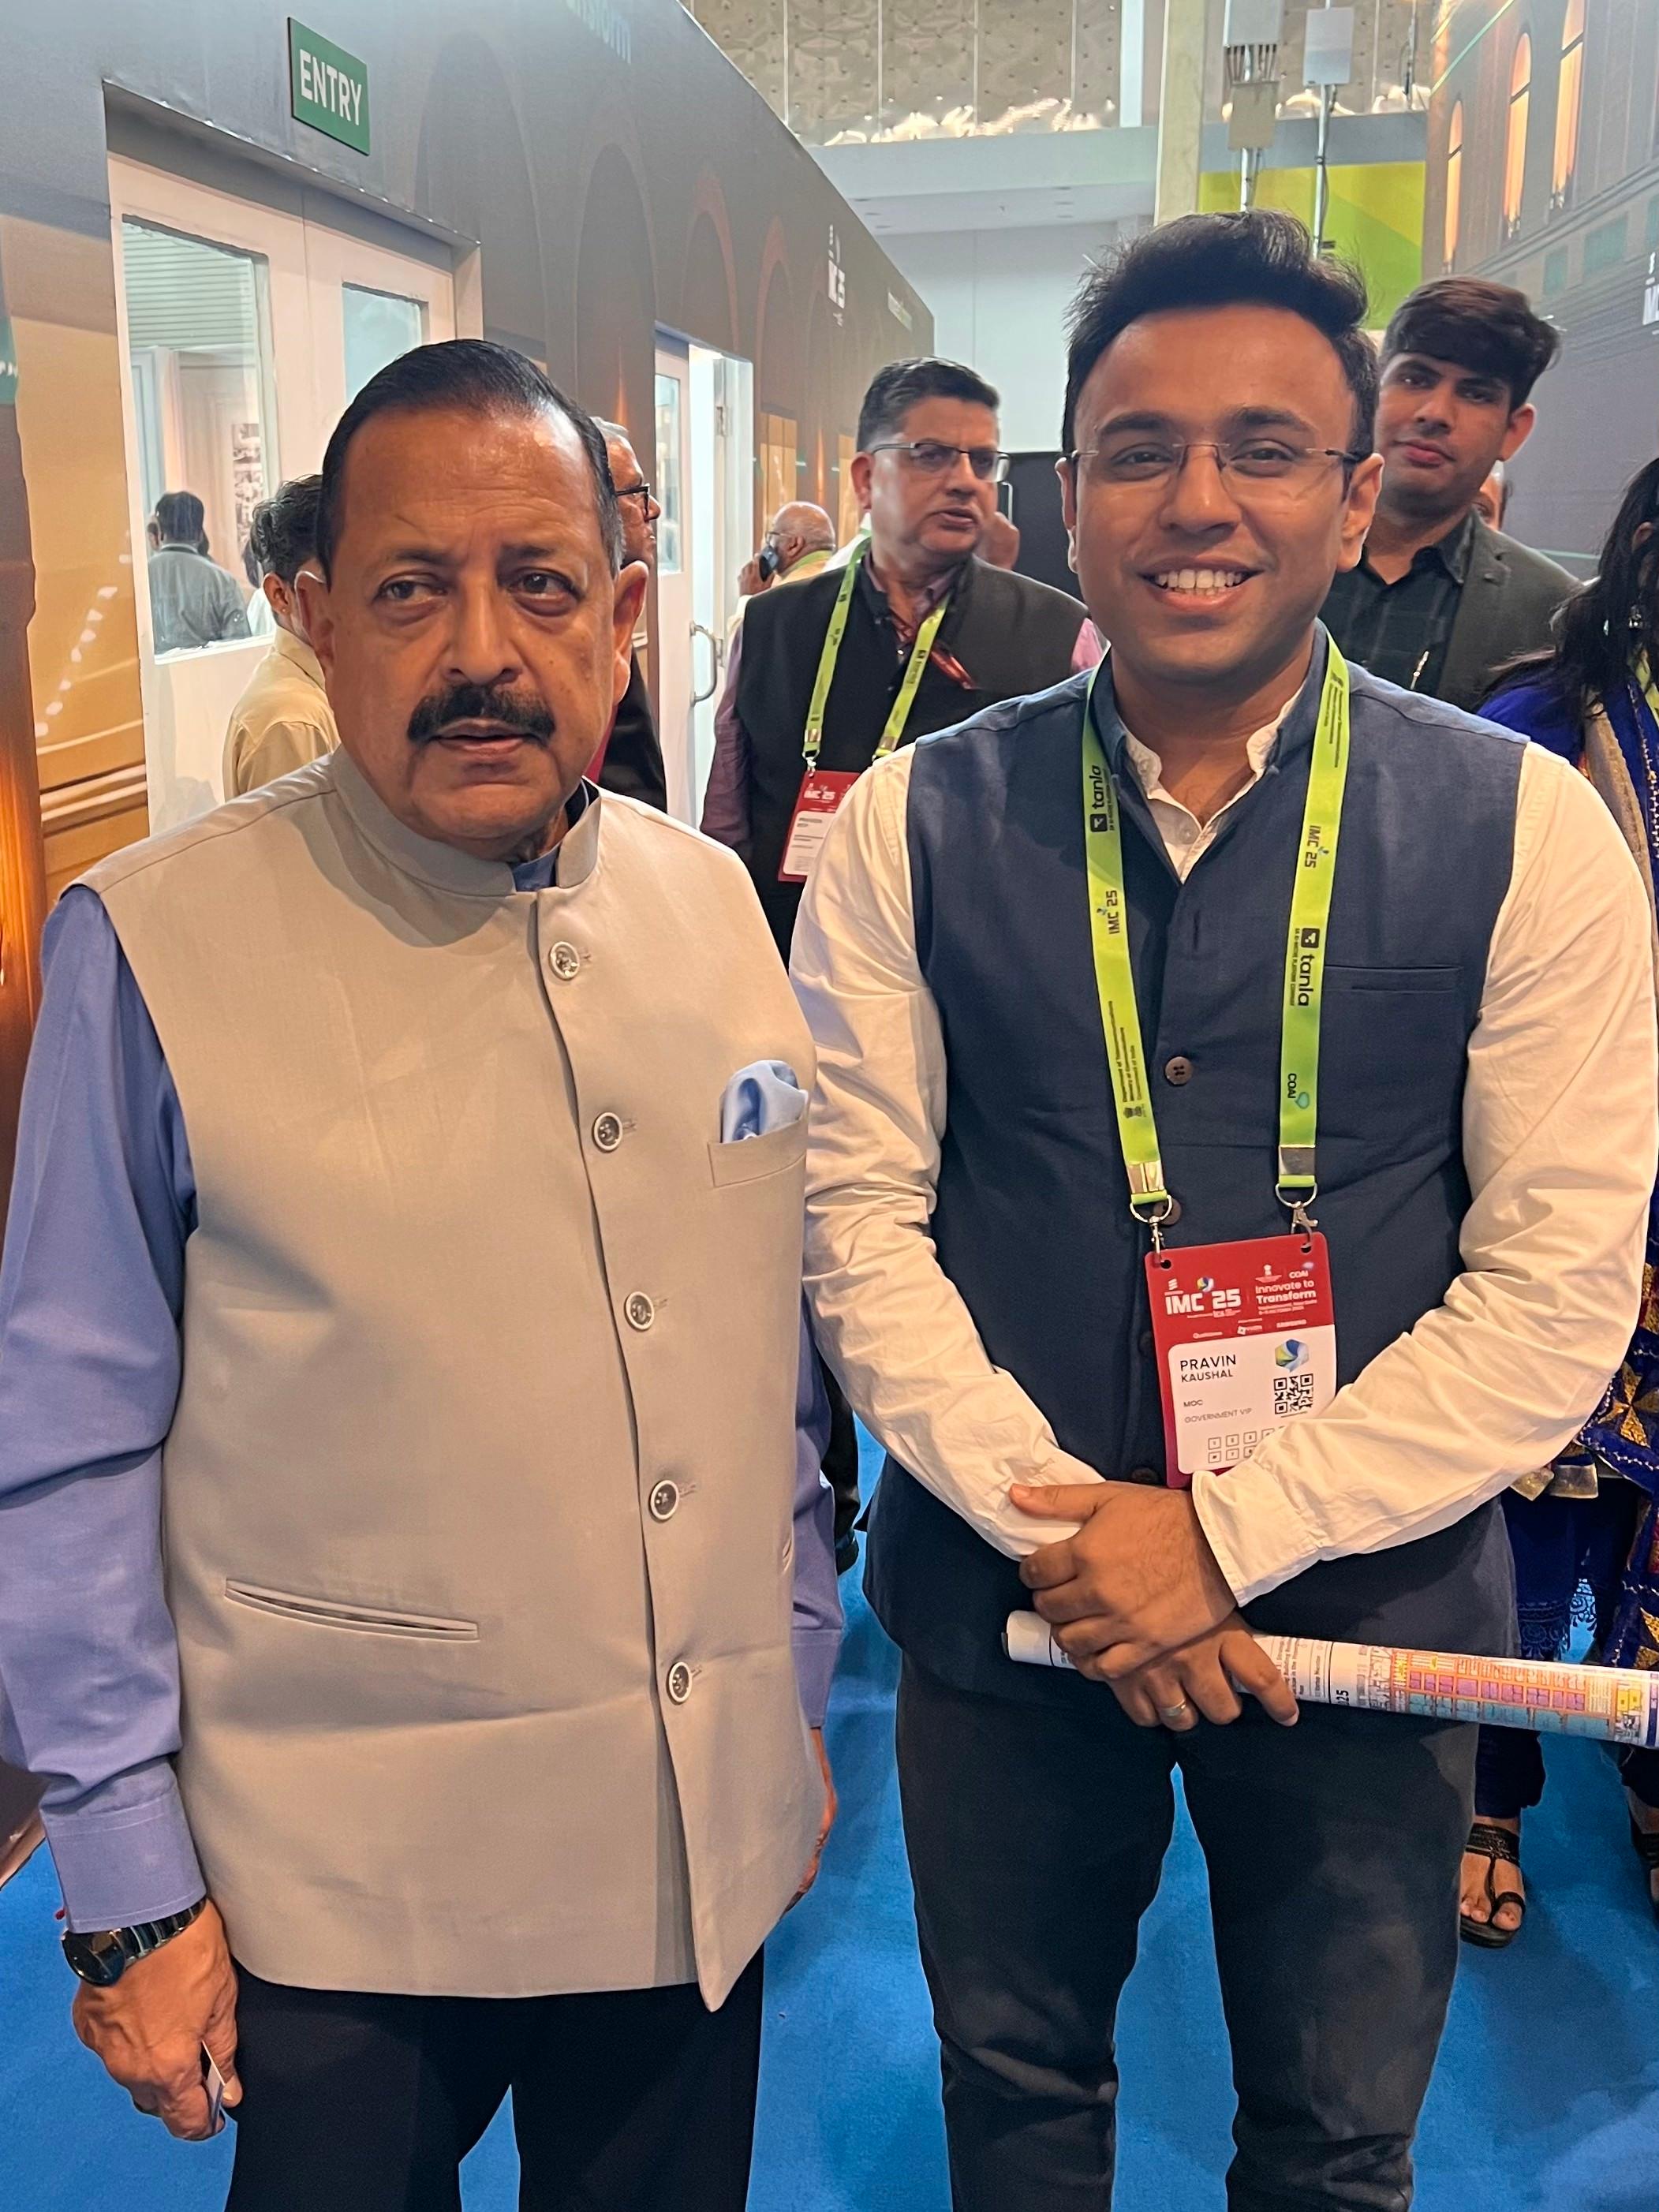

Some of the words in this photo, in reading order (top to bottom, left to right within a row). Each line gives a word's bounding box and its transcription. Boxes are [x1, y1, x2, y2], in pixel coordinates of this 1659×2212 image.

[300, 49, 361, 125] ENTRY
[1091, 764, 1104, 809] tanla
[1306, 825, 1321, 847] IMC
[1305, 851, 1317, 869] 25
[1106, 890, 1118, 907] 25
[1108, 912, 1119, 935] IMC
[1298, 954, 1315, 1007] tanla
[1287, 1073, 1297, 1099] COAI
[1255, 1282, 1302, 1294] Innovate
[1256, 1290, 1317, 1304] Transform
[1165, 1293, 1205, 1315] IMC
[1211, 1288, 1241, 1310] 25
[1180, 1354, 1236, 1371] PRAVIN
[1181, 1369, 1233, 1382] KAUSHAL
[1184, 1410, 1238, 1423] GOVERNMENT
